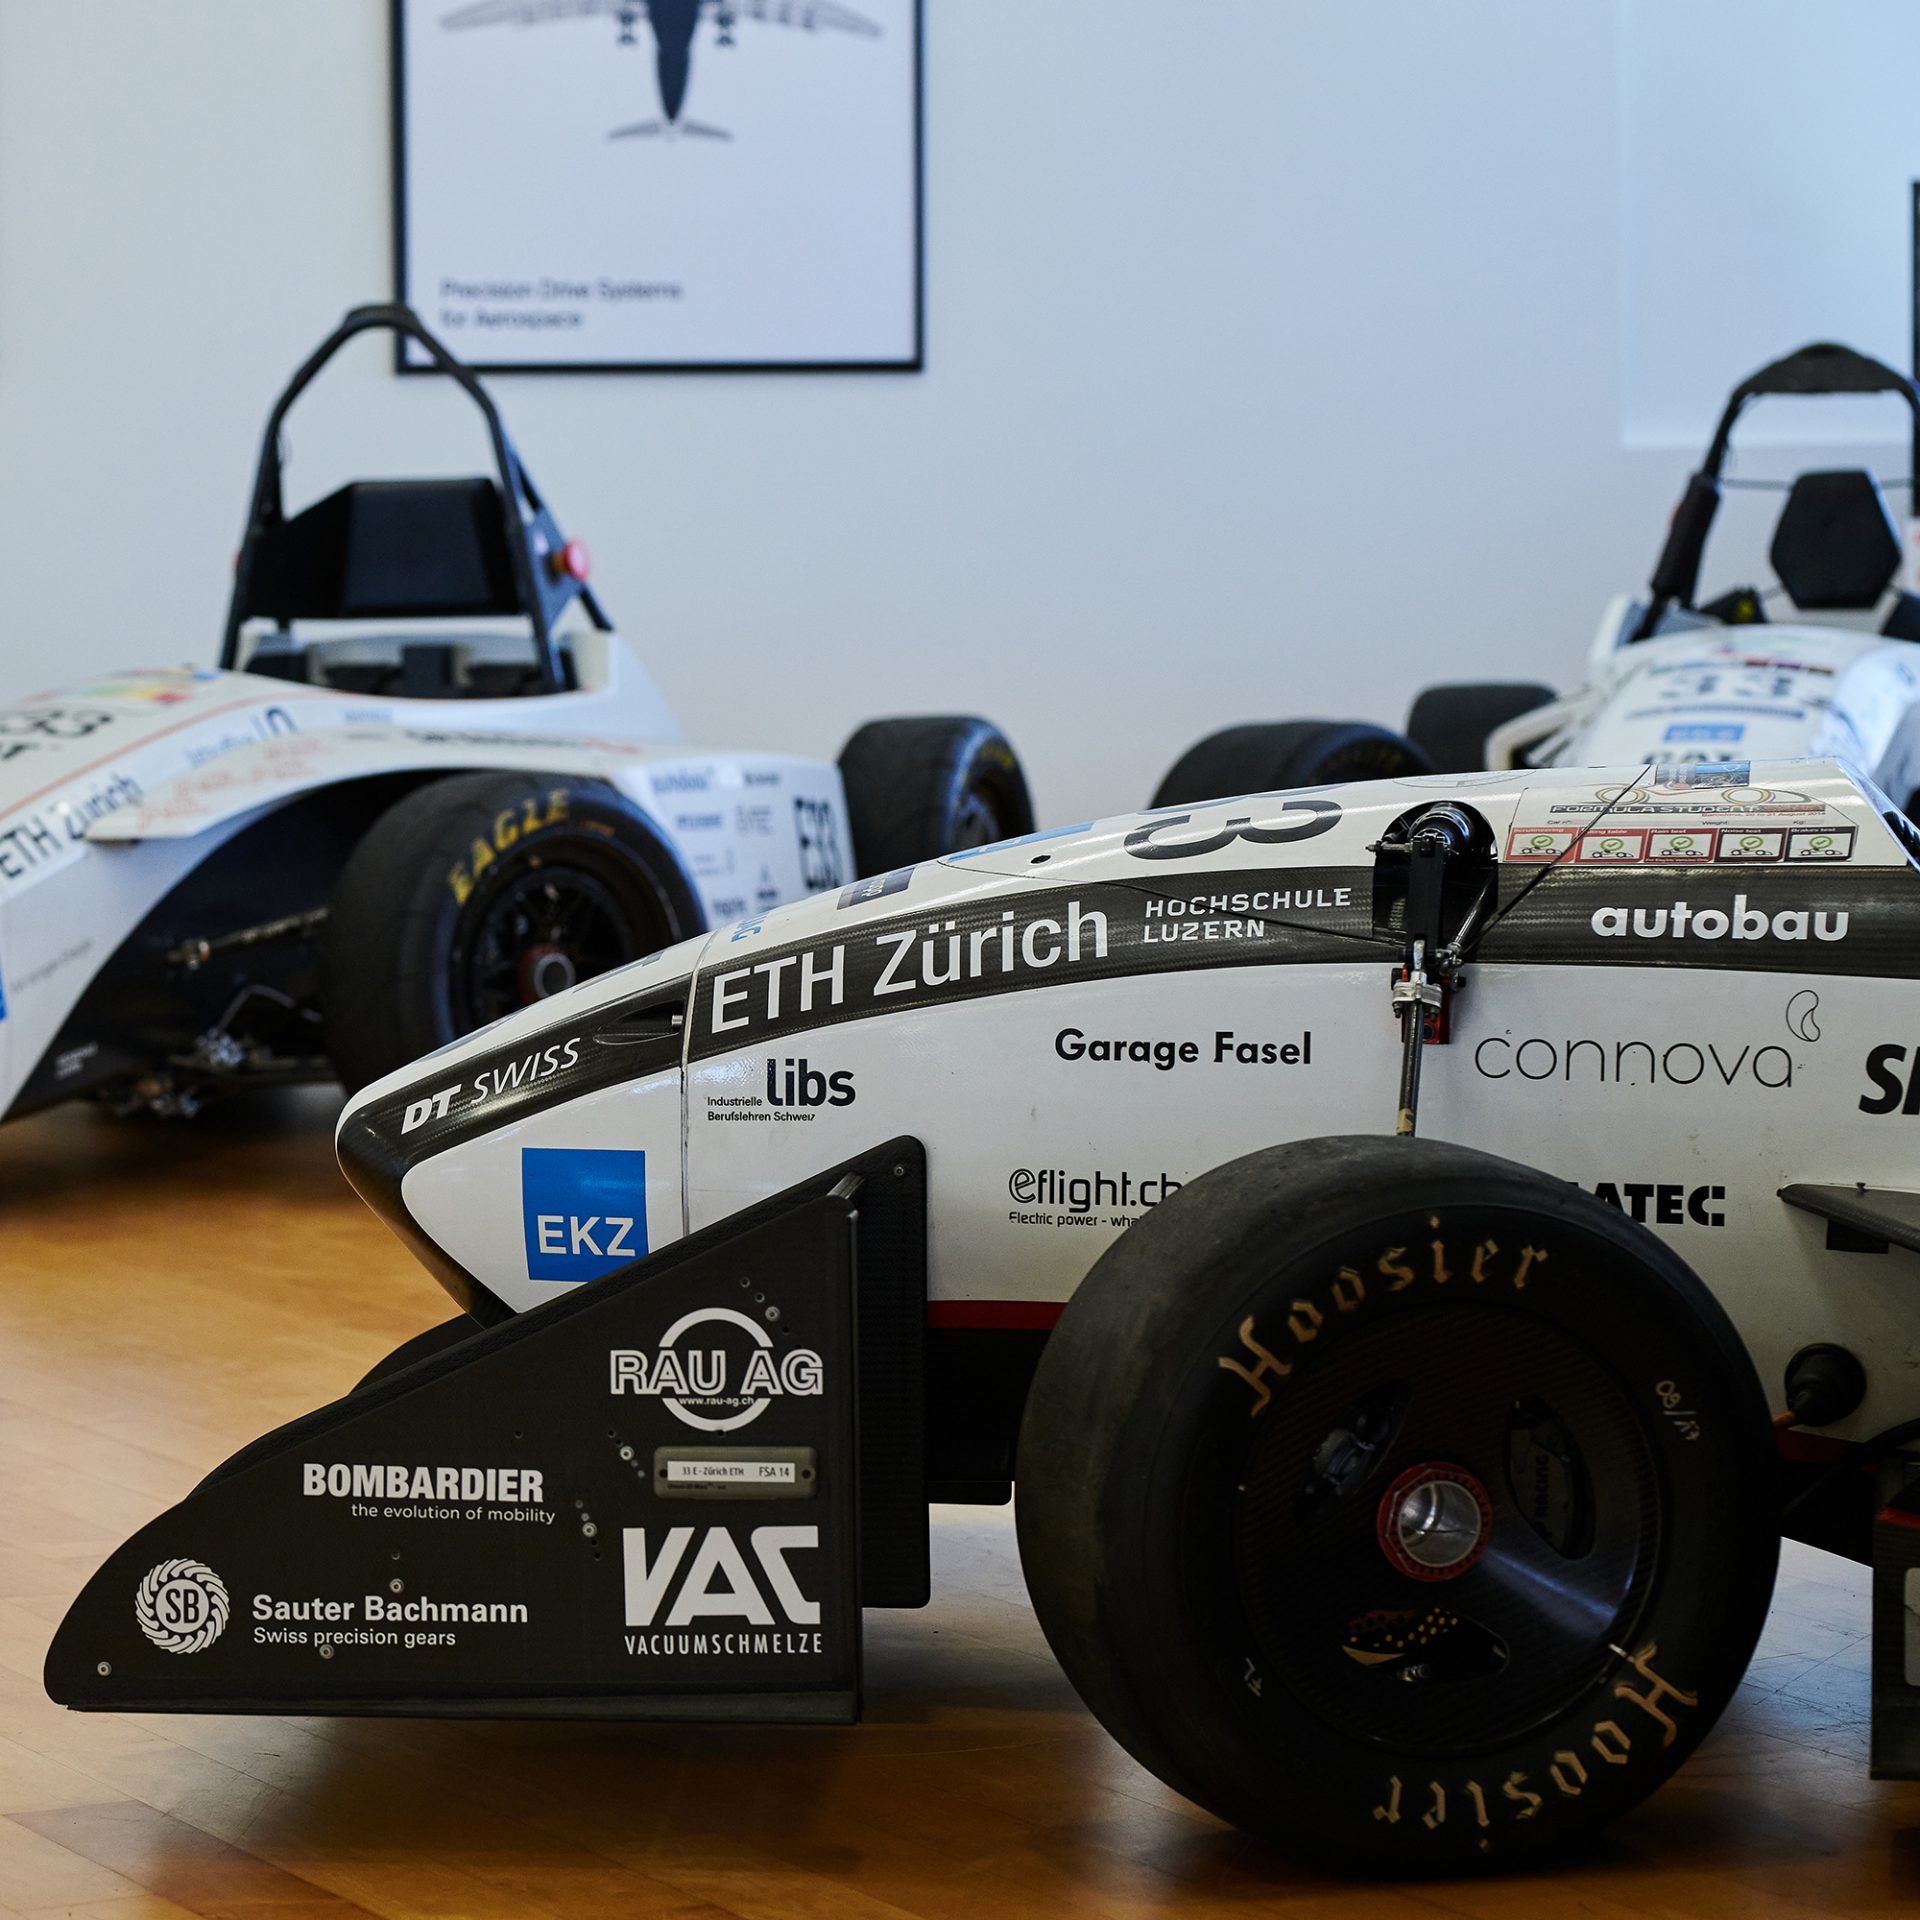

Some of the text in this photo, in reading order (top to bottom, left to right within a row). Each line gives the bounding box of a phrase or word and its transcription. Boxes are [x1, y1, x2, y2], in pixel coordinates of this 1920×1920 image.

[440, 279, 683, 303] Precision Drive Systems
[440, 308, 582, 330] for Aerospace
[0, 815, 63, 879] ETH
[449, 787, 571, 906] EAGLE
[1145, 887, 1352, 918] HOCHSCHULE
[1590, 894, 1850, 941] autobau
[1143, 919, 1265, 943] LUZERN
[711, 900, 1108, 1034] ETH Zürich
[1054, 1027, 1312, 1071] Garage Fasel
[1474, 1037, 1792, 1088] connova
[400, 1037, 581, 1135] DT SWISS
[706, 1096, 763, 1106] Industrielle
[766, 1058, 856, 1107] libs
[707, 1110, 771, 1122] Berufslehren
[1008, 1168, 1183, 1214] eflight.ch
[1566, 1181, 1726, 1227] ATEC
[537, 1214, 636, 1257] EKZ
[1008, 1211, 1053, 1225] Electric
[1057, 1214, 1098, 1228] power
[1218, 1215, 1549, 1419] Hoosier
[609, 1348, 824, 1396] RAU AG
[678, 1396, 756, 1408] www.rau-ag.ch
[303, 1463, 544, 1503] BOMBARDIER
[682, 1466, 691, 1476] 33
[692, 1466, 698, 1476] E
[703, 1466, 728, 1477] Zürich
[729, 1467, 745, 1477] ETH
[758, 1466, 777, 1478] FSA
[779, 1466, 790, 1478] 14
[351, 1503, 556, 1525] the evolution of mobility
[622, 1525, 821, 1627] VAC
[164, 1588, 201, 1624] SB
[252, 1594, 528, 1623] Sauter Bachmann
[253, 1627, 456, 1649] Swiss precision gears
[624, 1633, 823, 1655] VACUUMSCHMELZE
[1372, 1641, 1698, 1852] Hoosier
